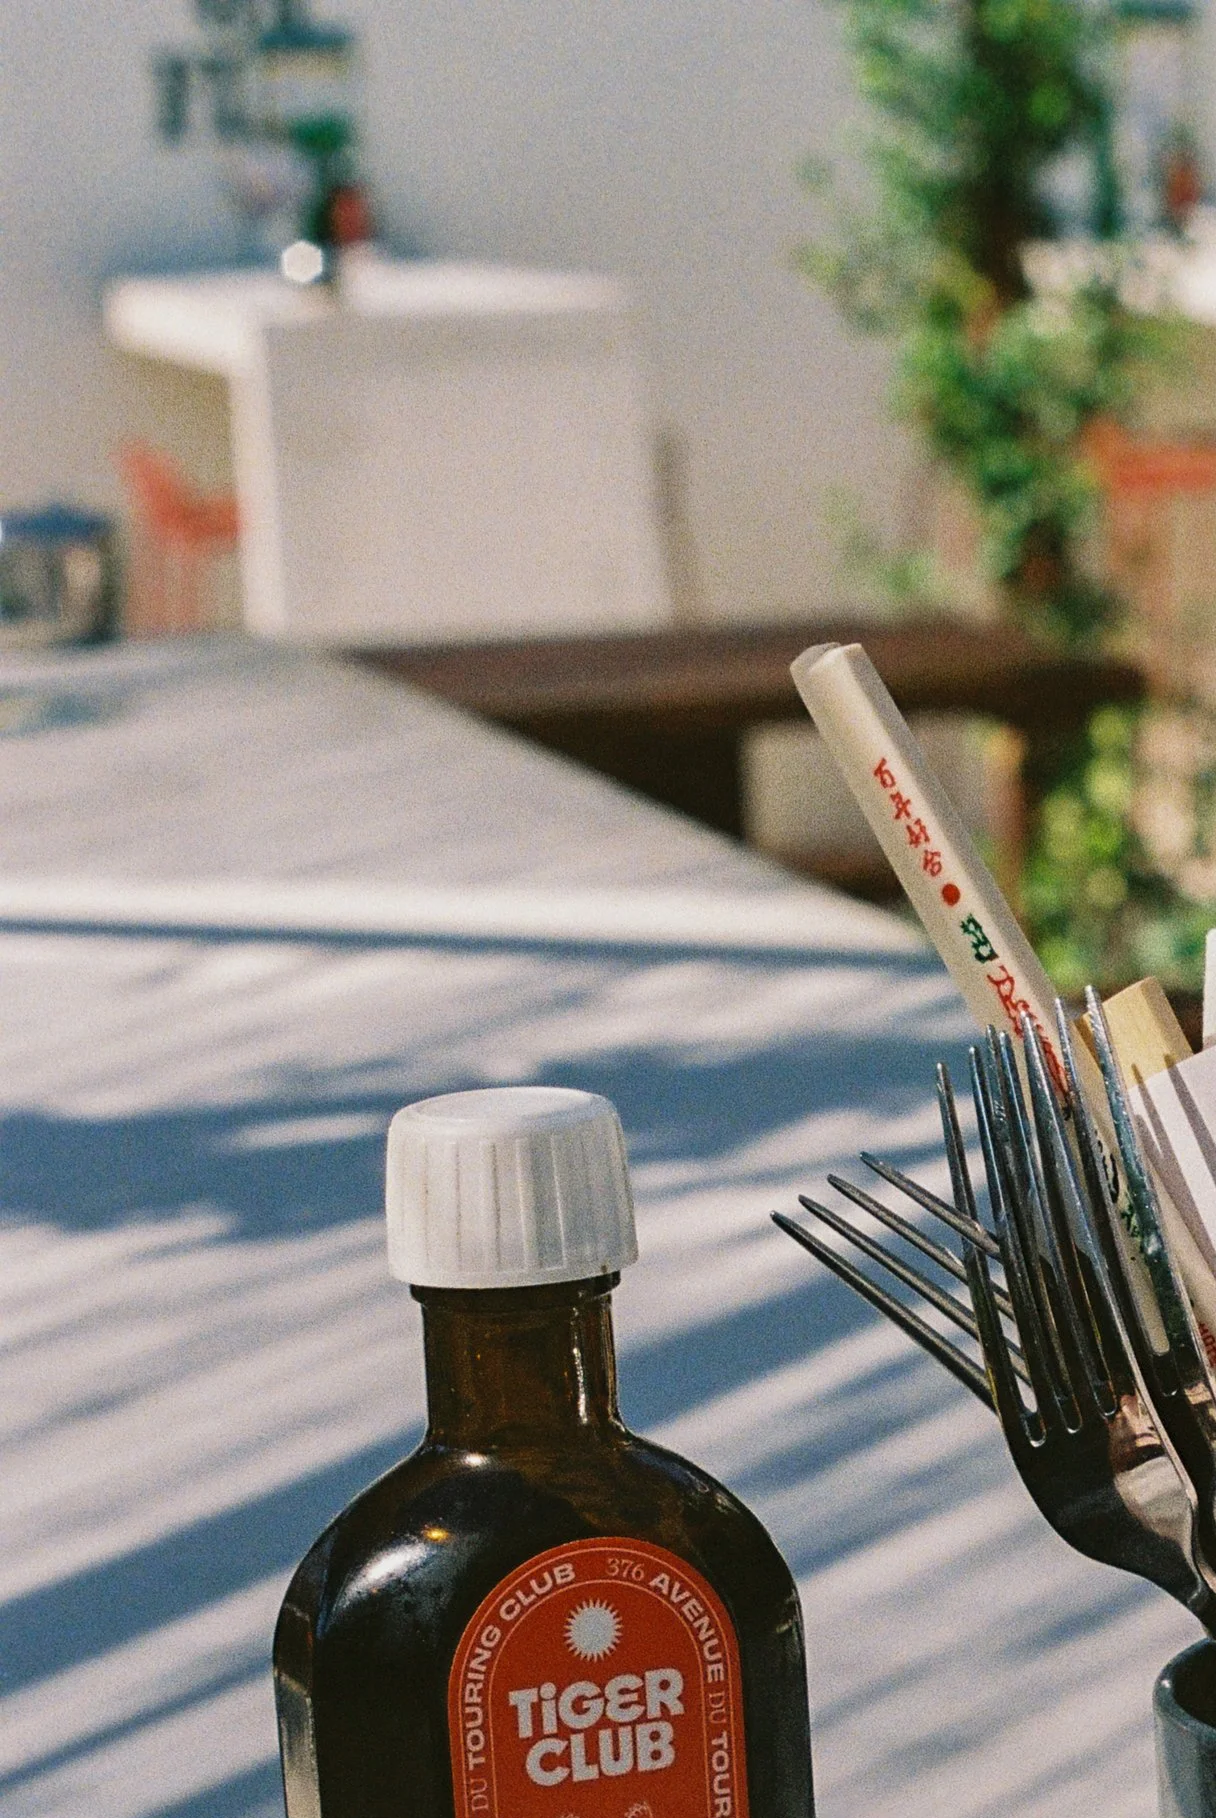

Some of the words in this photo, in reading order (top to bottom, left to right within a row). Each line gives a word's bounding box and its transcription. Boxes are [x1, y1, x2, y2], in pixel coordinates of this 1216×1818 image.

[499, 1563, 576, 1622] CLUB
[605, 1557, 646, 1582] 376
[649, 1572, 725, 1684] AVENUE
[709, 1691, 727, 1725] DU
[464, 1624, 501, 1770] TOURING
[525, 1720, 676, 1787] CLUB
[469, 1778, 489, 1812] DU
